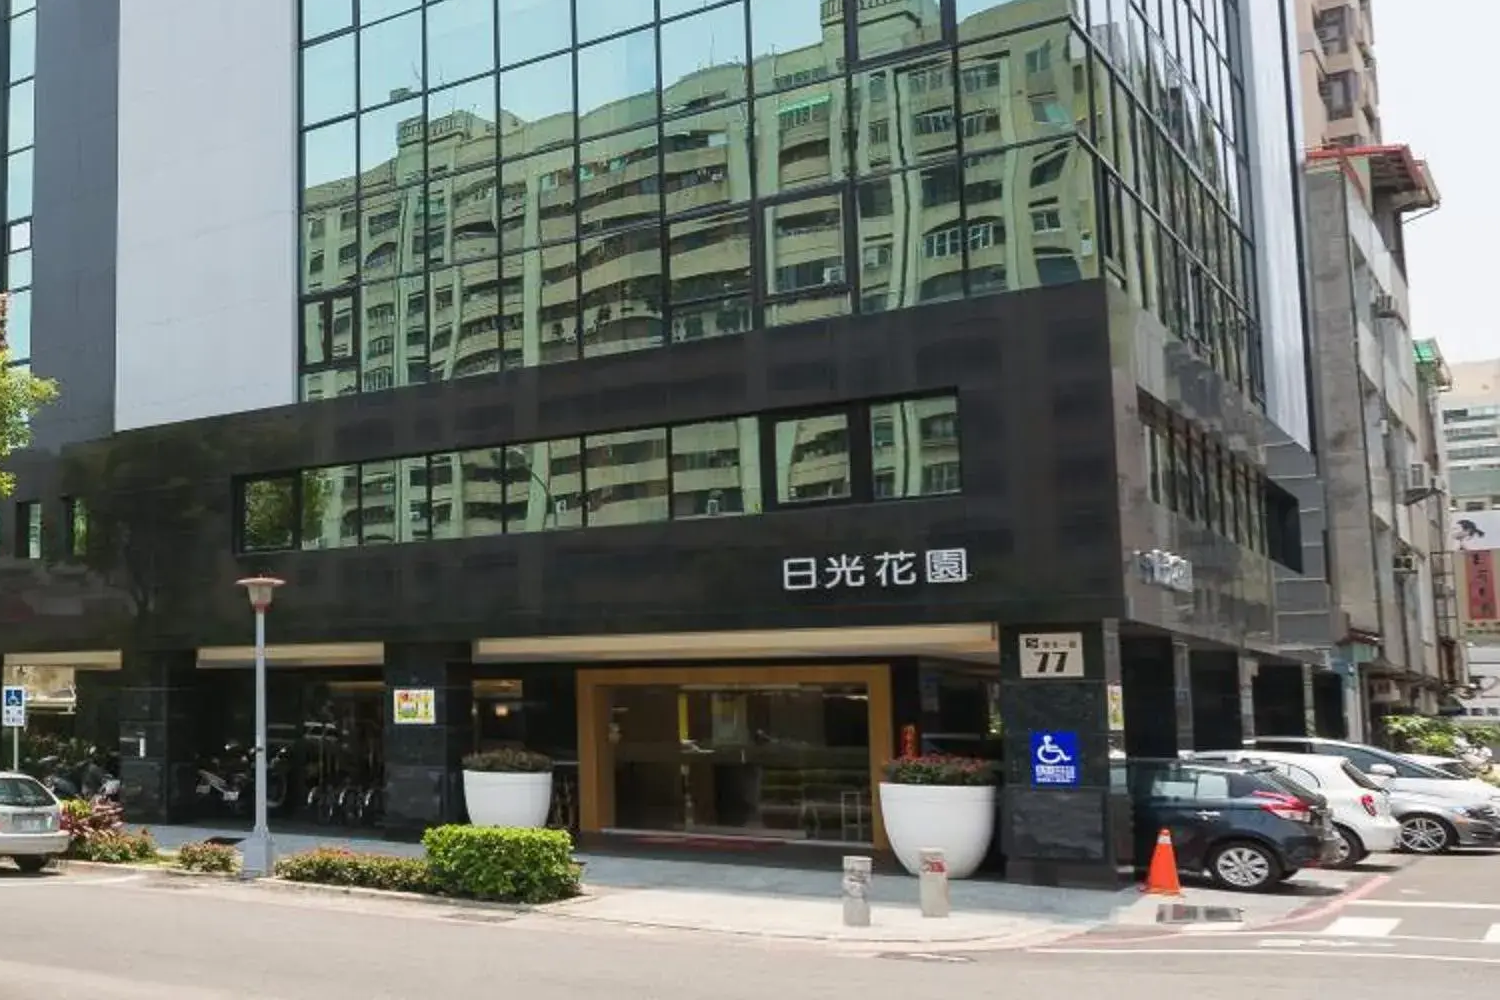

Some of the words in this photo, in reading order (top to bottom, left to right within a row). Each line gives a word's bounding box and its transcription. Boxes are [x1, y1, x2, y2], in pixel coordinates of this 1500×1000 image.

[783, 547, 968, 590] 日光花園
[1033, 651, 1069, 673] 77
